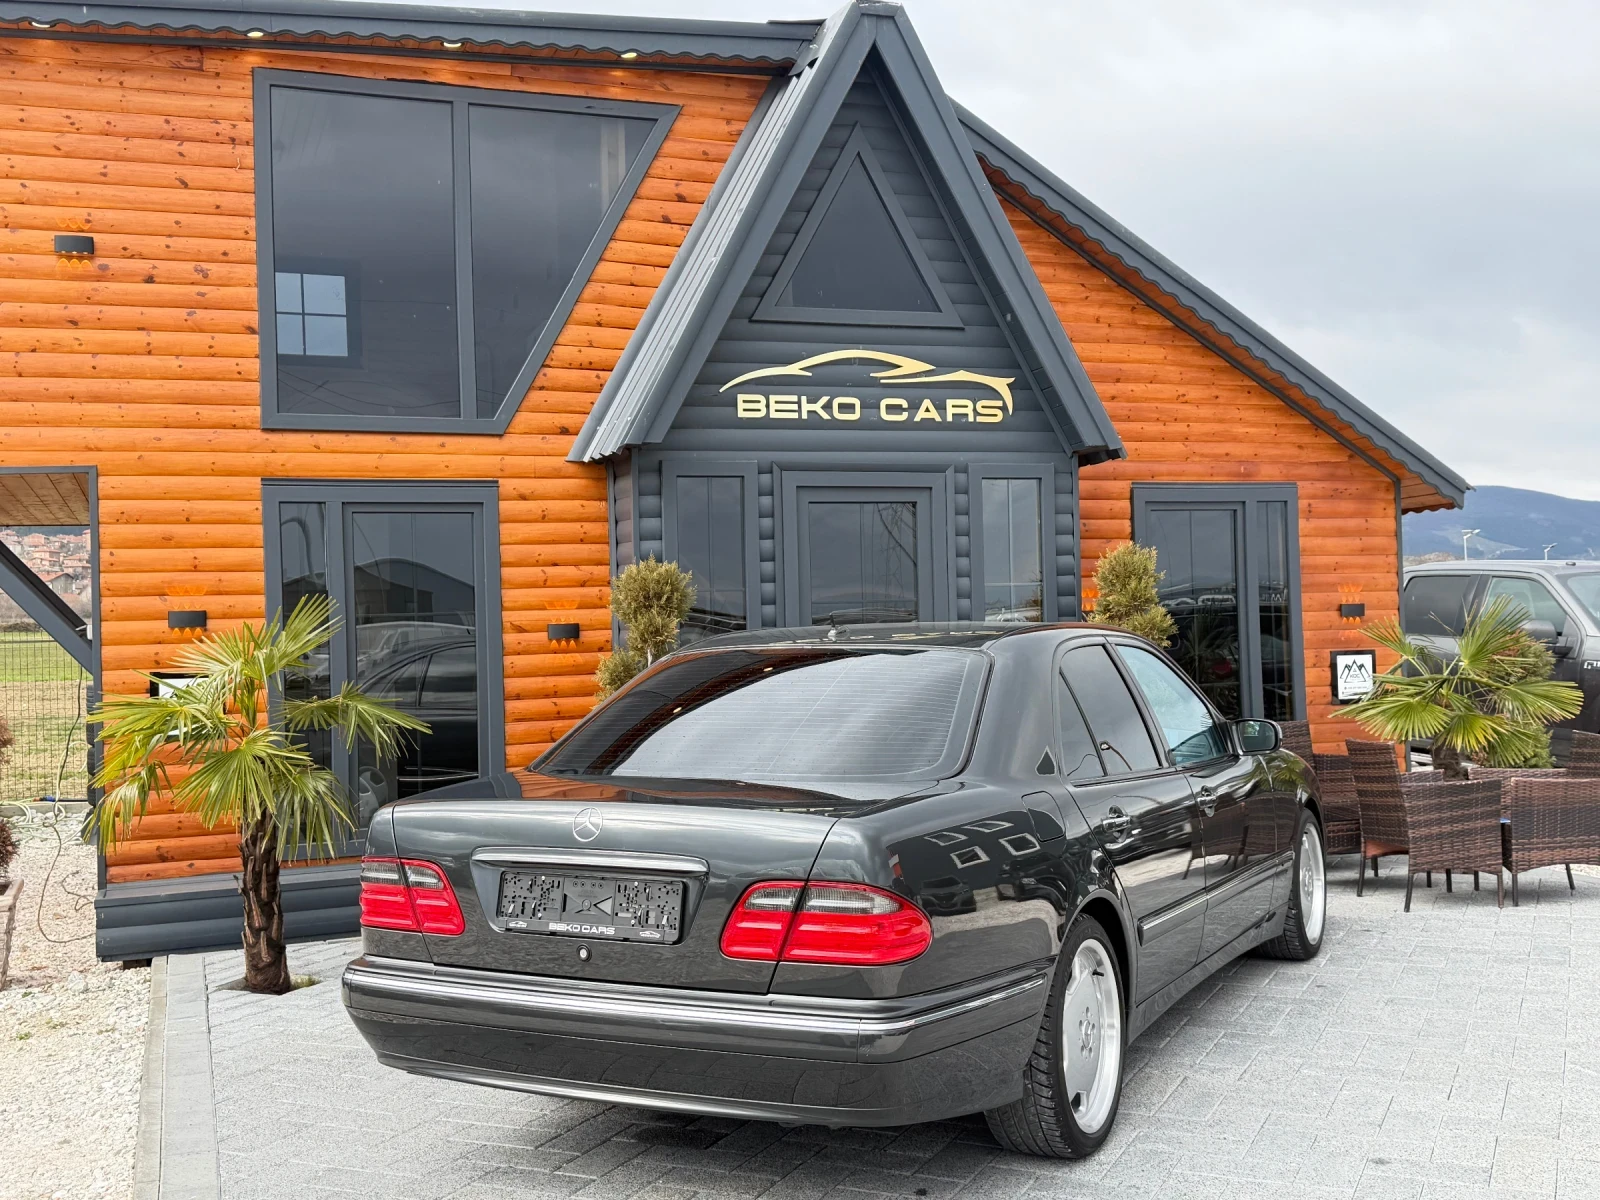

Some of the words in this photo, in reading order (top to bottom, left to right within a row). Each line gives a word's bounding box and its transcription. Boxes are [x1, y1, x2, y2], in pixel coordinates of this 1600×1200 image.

[737, 393, 862, 421] BEKO
[879, 397, 1004, 423] CARS
[548, 922, 581, 932] BEKO
[581, 925, 616, 935] CARS
